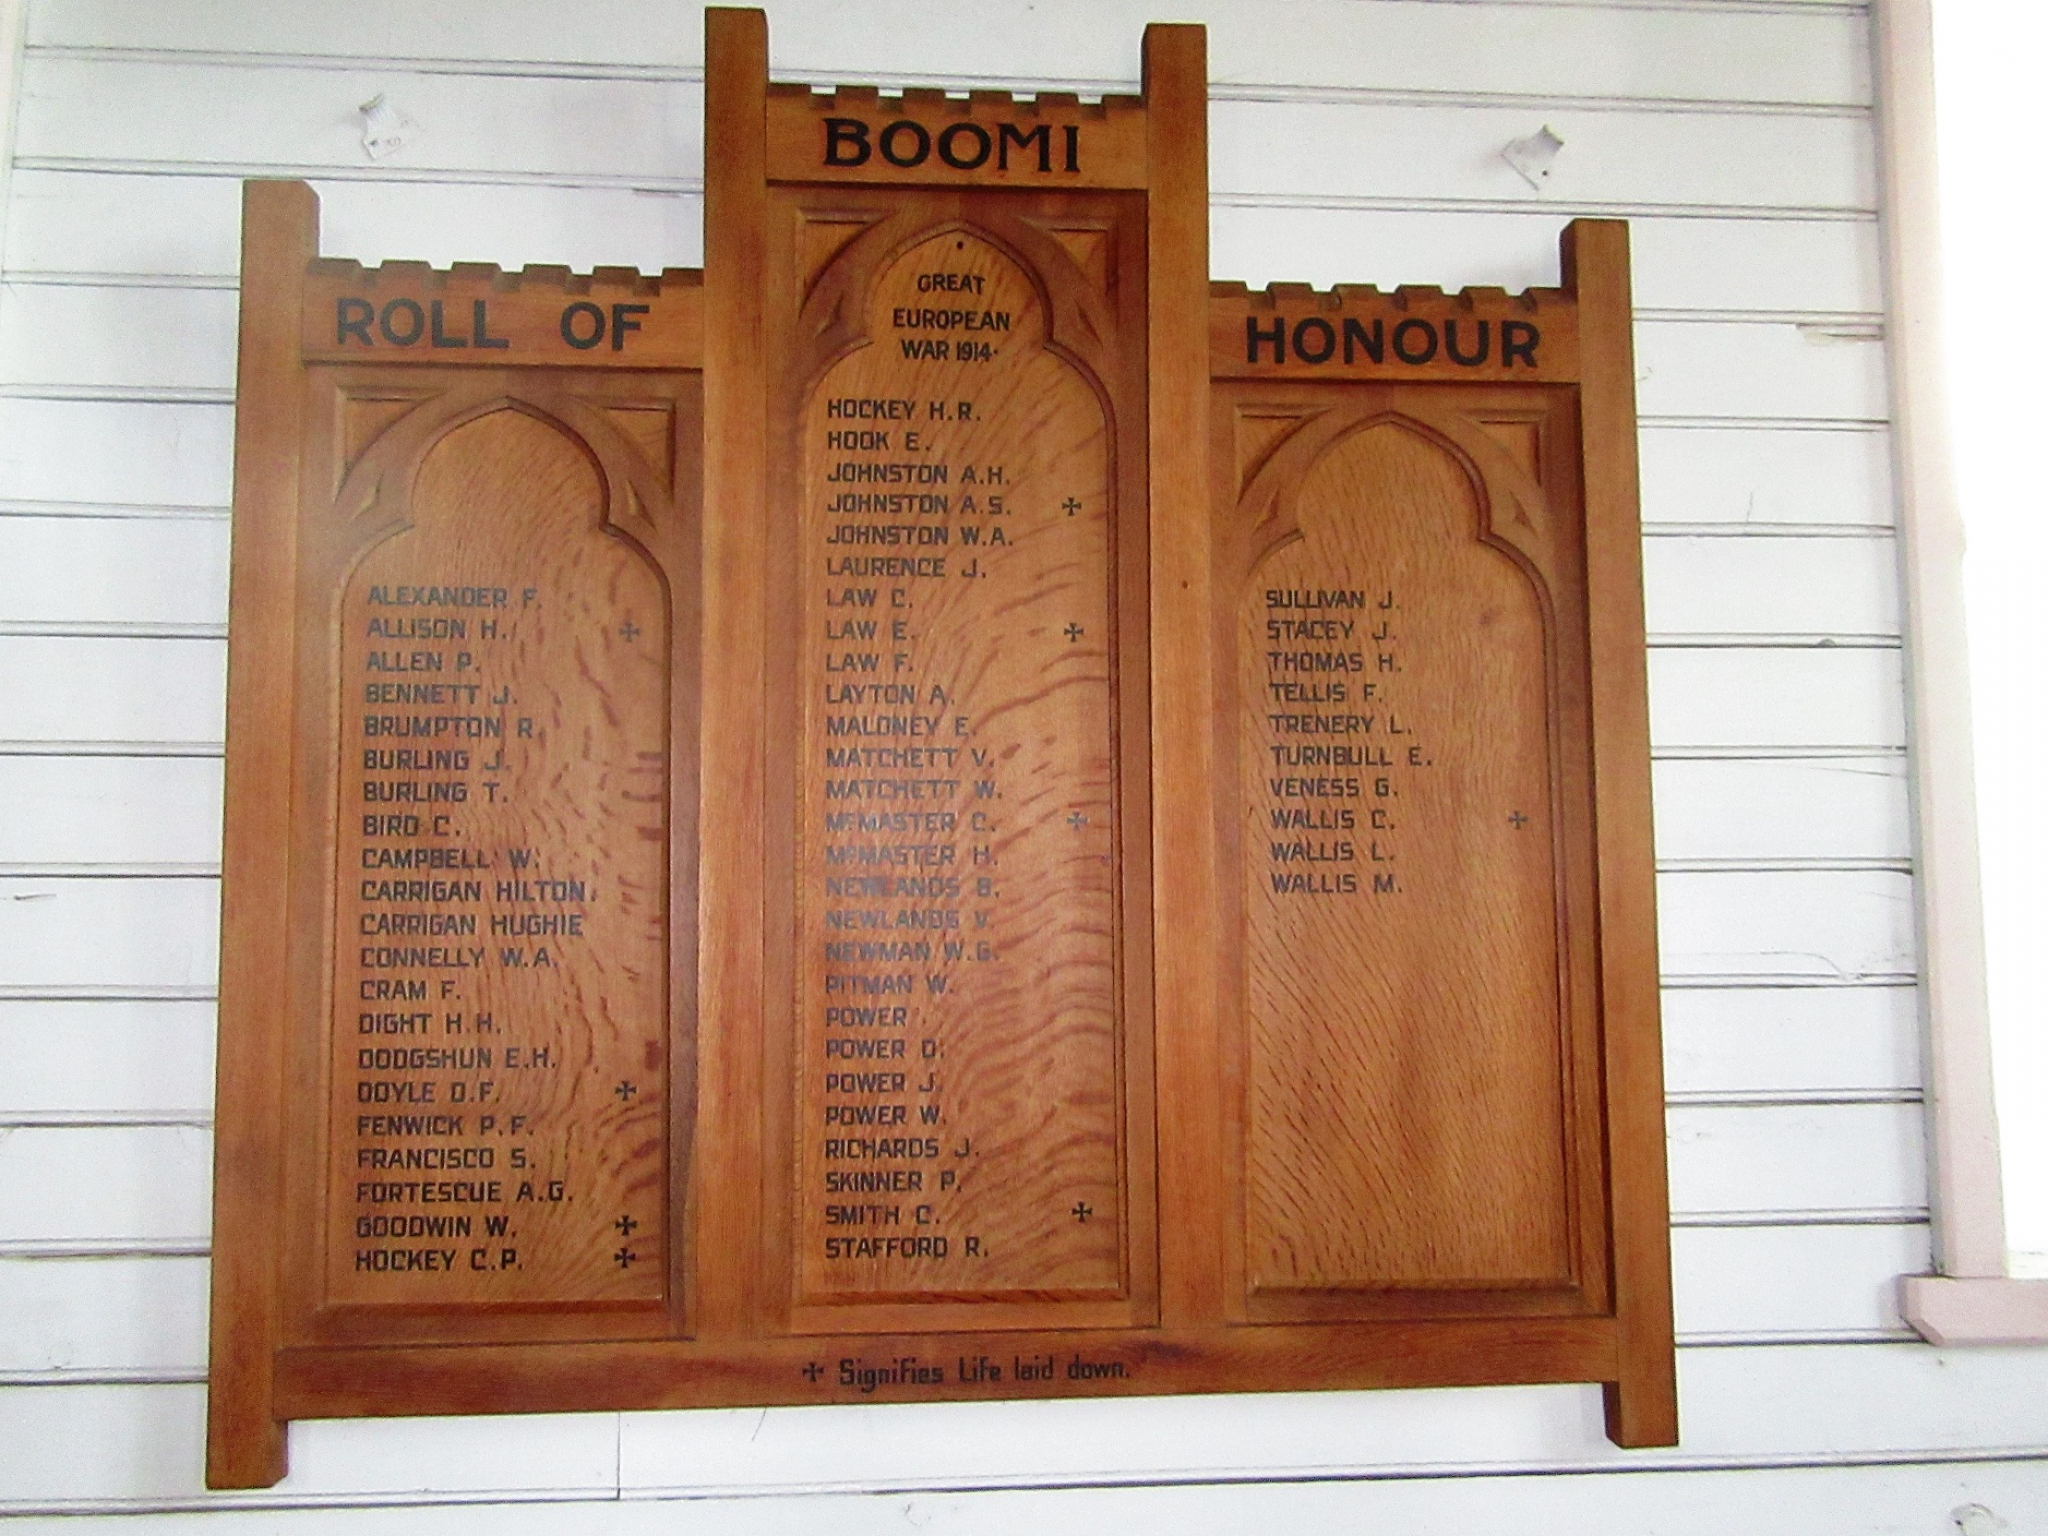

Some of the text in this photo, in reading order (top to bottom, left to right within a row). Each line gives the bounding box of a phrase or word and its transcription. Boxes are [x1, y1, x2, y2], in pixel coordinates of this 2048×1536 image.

[823, 118, 1081, 172] BOOMI
[918, 274, 985, 295] GREAT
[336, 298, 650, 351] ROLL OF
[893, 308, 1010, 331] EUROPEAN
[901, 340, 949, 360] WAR
[1246, 316, 1540, 368] HONOUR
[828, 399, 981, 421] HOCKEY H.R.
[828, 431, 930, 451] HOOK E.
[828, 463, 948, 484] JOHNSTON
[827, 494, 948, 514] JOHNSTON
[827, 526, 948, 546] JOHNSTON
[826, 558, 945, 578] LAURENCE
[367, 585, 508, 608] ALEXANDER
[826, 588, 876, 608] LAW
[1266, 590, 1364, 609] SULLIVAN
[367, 618, 466, 639] ALLISON
[826, 620, 876, 640] LAW
[1267, 621, 1354, 640] STACEY
[366, 652, 442, 672] ALLEN
[826, 654, 879, 672] LAW
[1269, 652, 1362, 672] THOMAS
[365, 684, 480, 704] BENNETT
[826, 684, 915, 704] LAYTON
[1270, 684, 1345, 702] TELLIS
[364, 716, 501, 738] BRUMPTON
[826, 716, 939, 736] MALONEY
[1270, 715, 1374, 734] TRENERY
[364, 749, 469, 770] BURLING
[826, 748, 958, 768] MATCHETT
[1270, 746, 1392, 766] TURNBULL
[363, 781, 467, 802] BURLING
[826, 780, 960, 799] MATCHETT
[1270, 778, 1359, 797] VENESS
[363, 815, 419, 836] BIRD
[1270, 810, 1354, 830] WALLIS
[361, 849, 490, 869] CAMPBELL
[1271, 842, 1353, 861] WALLIS
[361, 881, 481, 901] CARRIGAN
[826, 877, 960, 897] NEWLANDS
[1271, 874, 1356, 893] WALLIS
[360, 914, 476, 935] CARRIGAN
[826, 910, 959, 930] NEWLANDS
[361, 947, 485, 968] CONNELLY
[826, 942, 930, 962] NEWMAN
[360, 980, 426, 1000] CRAM
[826, 975, 912, 994] PITMAN
[359, 1013, 432, 1034] DIGHT
[826, 1008, 907, 1027] POWER
[358, 1048, 491, 1069] DODGSHUN
[826, 1039, 905, 1058] POWER
[358, 1082, 435, 1103] DOYLE
[826, 1073, 905, 1093] POWER
[357, 1115, 463, 1136] FENWICK
[826, 1106, 906, 1126] POWER
[826, 1138, 939, 1158] RICHARDS
[357, 1149, 494, 1170] FRANCISCO
[826, 1171, 922, 1192] SKINNER
[356, 1182, 501, 1203] FORTESCUE
[826, 1205, 940, 1224] SMITH C.
[356, 1216, 517, 1238] GOODWIN W.
[826, 1237, 988, 1258] STAFFORD R.
[355, 1249, 523, 1272] HOCKEY C.P.
[839, 1354, 1130, 1393] Signifies Life laid down.
